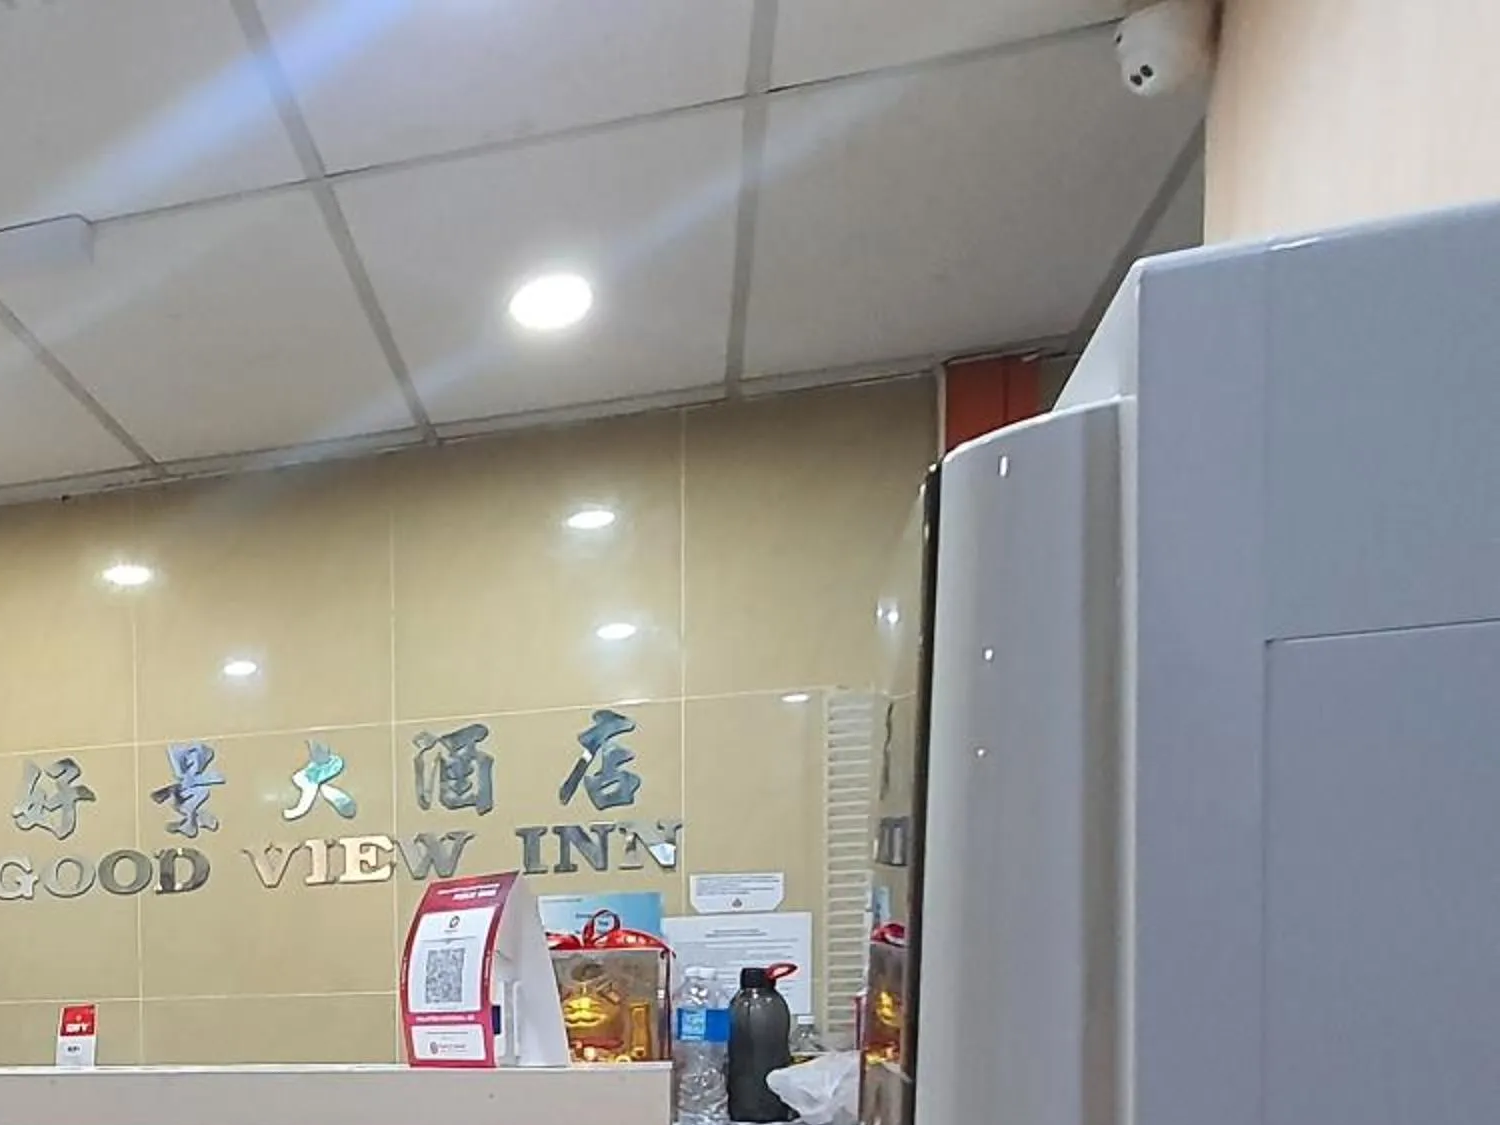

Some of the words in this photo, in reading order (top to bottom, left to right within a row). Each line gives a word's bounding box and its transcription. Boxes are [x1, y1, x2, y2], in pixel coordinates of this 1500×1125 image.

[11, 709, 641, 840] 好景大酒店
[242, 831, 476, 888] VIEW
[516, 821, 683, 875] INN
